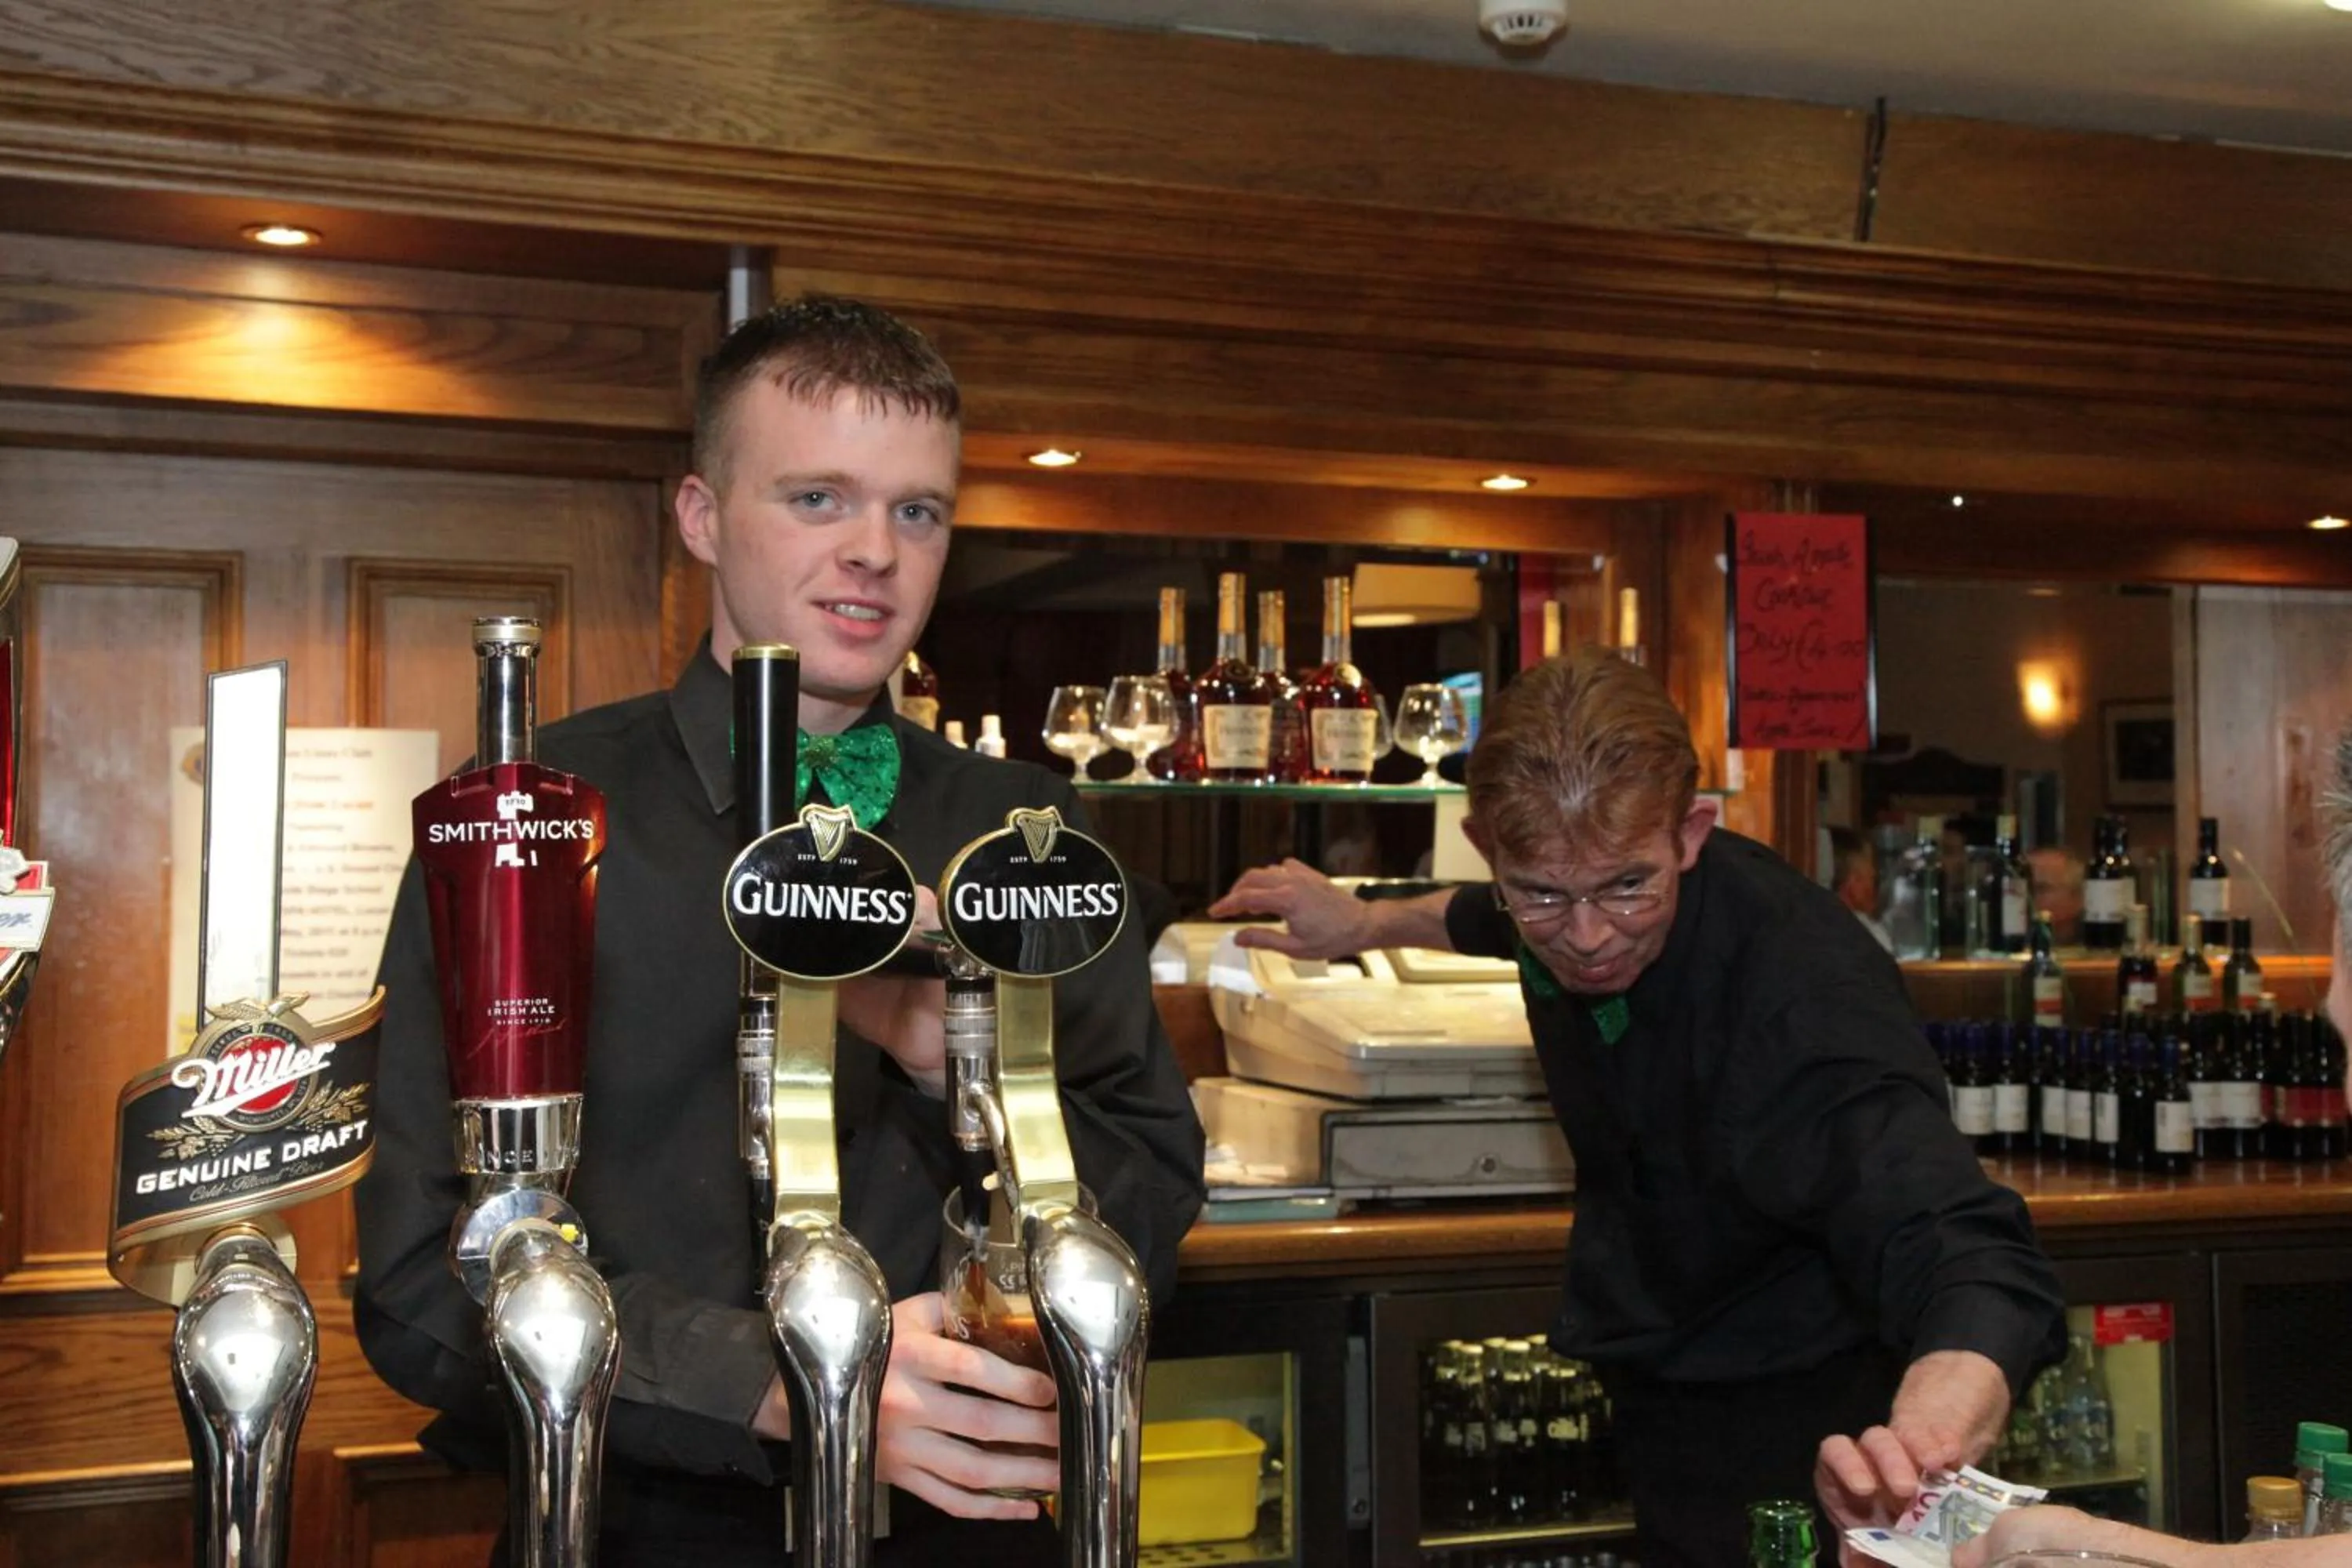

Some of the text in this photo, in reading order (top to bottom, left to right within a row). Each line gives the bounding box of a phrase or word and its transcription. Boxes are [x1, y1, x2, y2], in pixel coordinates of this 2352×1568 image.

[429, 818, 596, 843] SMITHWICK'S
[732, 873, 908, 924] GUINNESS
[954, 882, 1119, 922] GUINNESS
[487, 1005, 556, 1016] IRISH ALE
[495, 998, 549, 1007] SUPERIOR
[172, 1042, 336, 1118] Miller
[136, 1120, 368, 1195] GENUINE DRAFT
